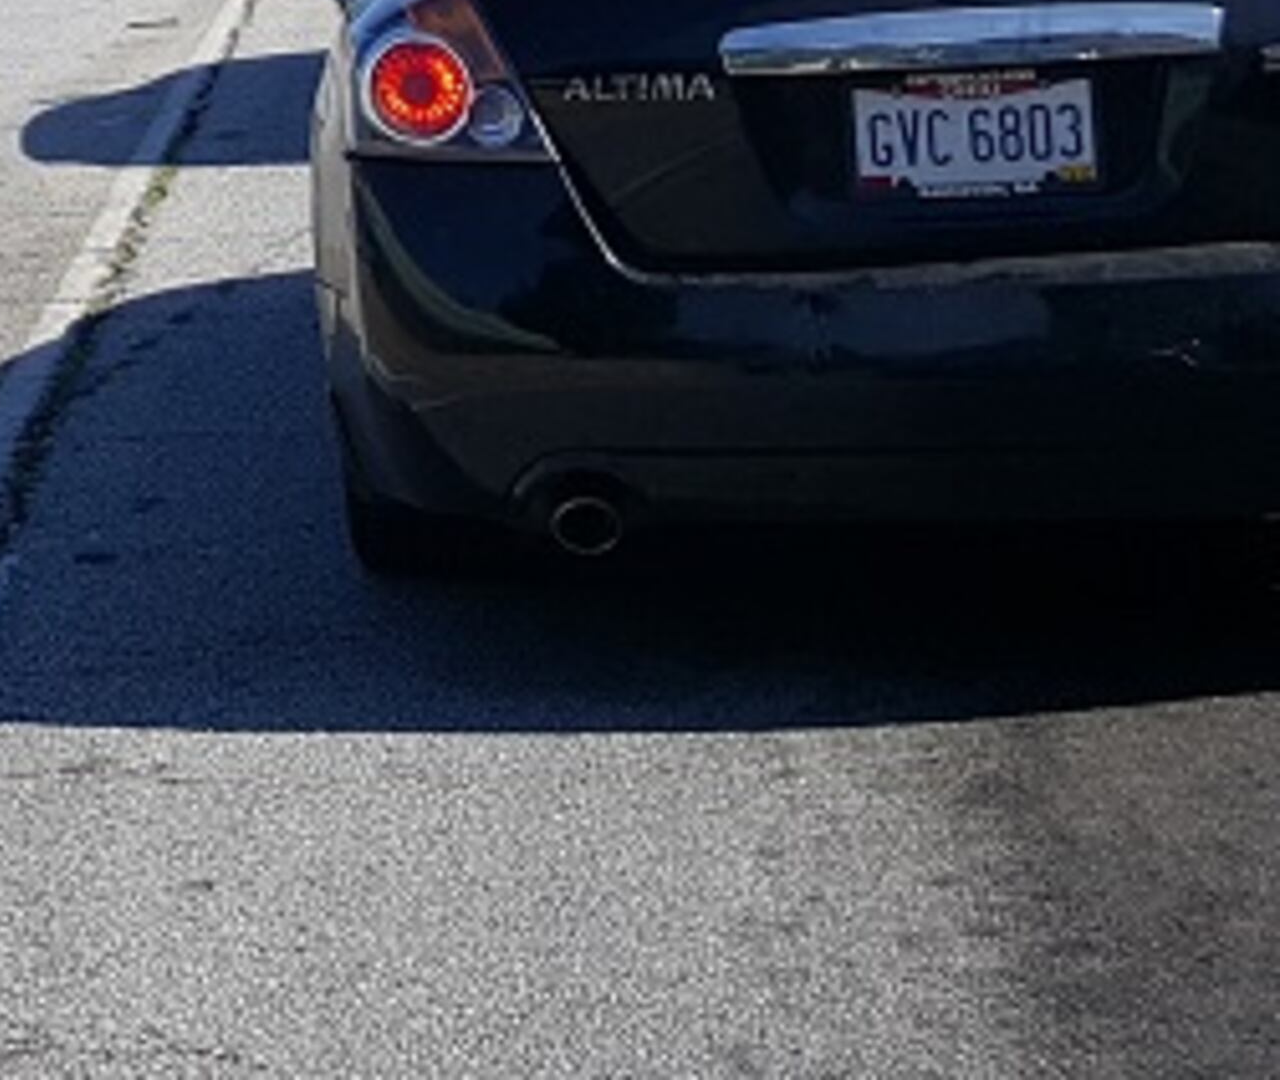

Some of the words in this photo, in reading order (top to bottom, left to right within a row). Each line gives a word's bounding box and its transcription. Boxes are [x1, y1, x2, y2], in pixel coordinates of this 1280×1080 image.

[563, 72, 715, 102] ALTIMA
[868, 108, 953, 168] GVC
[967, 103, 1083, 163] 6803
